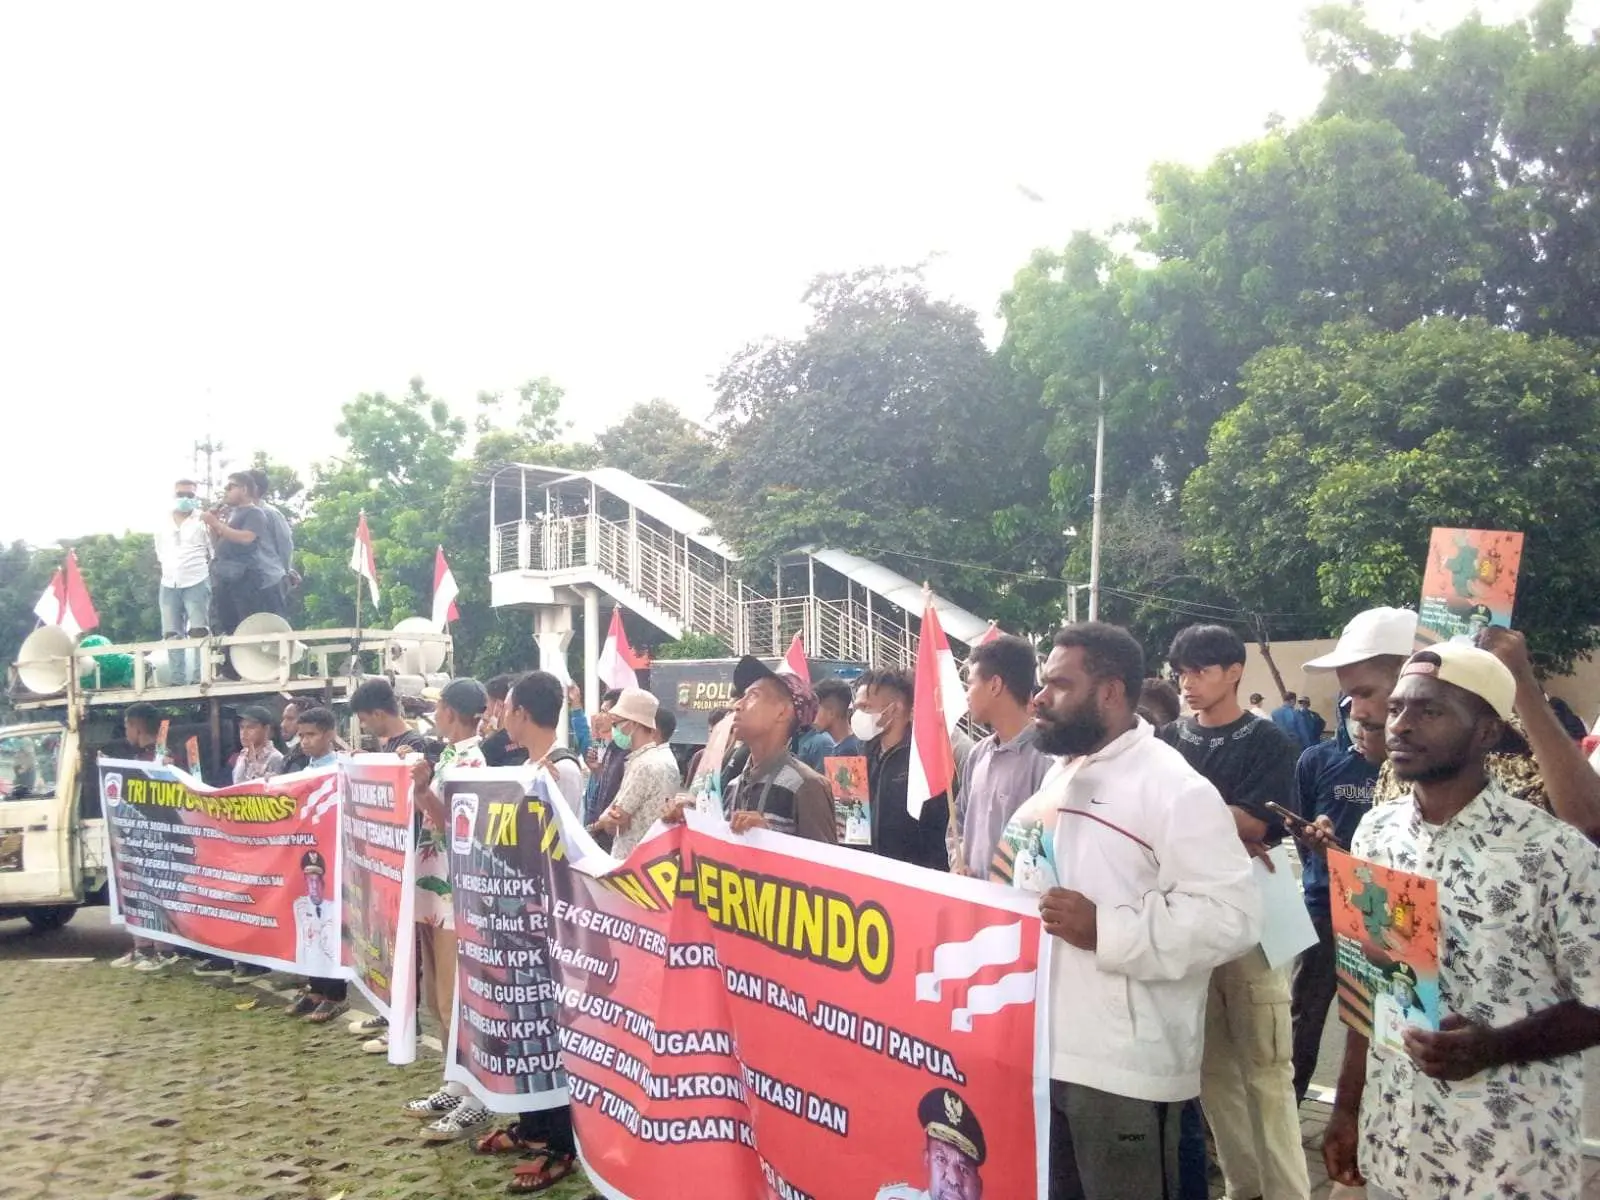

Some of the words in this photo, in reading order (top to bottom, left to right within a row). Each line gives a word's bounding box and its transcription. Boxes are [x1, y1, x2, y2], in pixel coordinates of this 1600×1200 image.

[696, 682, 734, 699] POLI
[127, 779, 147, 804] TRI
[484, 802, 519, 846] TRI
[503, 878, 536, 896] KPK
[490, 913, 524, 932] Takut
[507, 949, 544, 968] KPK
[552, 899, 636, 944] EKSEKUSI
[637, 927, 667, 957] TERS
[727, 969, 762, 1000] DAN
[767, 981, 808, 1021] RAJA
[812, 1006, 856, 1041] JUDI
[861, 1023, 882, 1050] DI
[888, 1030, 965, 1082] PAPUA.
[512, 1018, 551, 1038] KPK
[557, 1025, 615, 1067] NEMBE
[616, 1052, 640, 1081] DAN
[654, 1032, 730, 1054] UGAAN
[506, 1053, 564, 1074] PAPUA
[807, 1095, 846, 1134] DAN
[641, 1119, 734, 1142] DUGAAN
